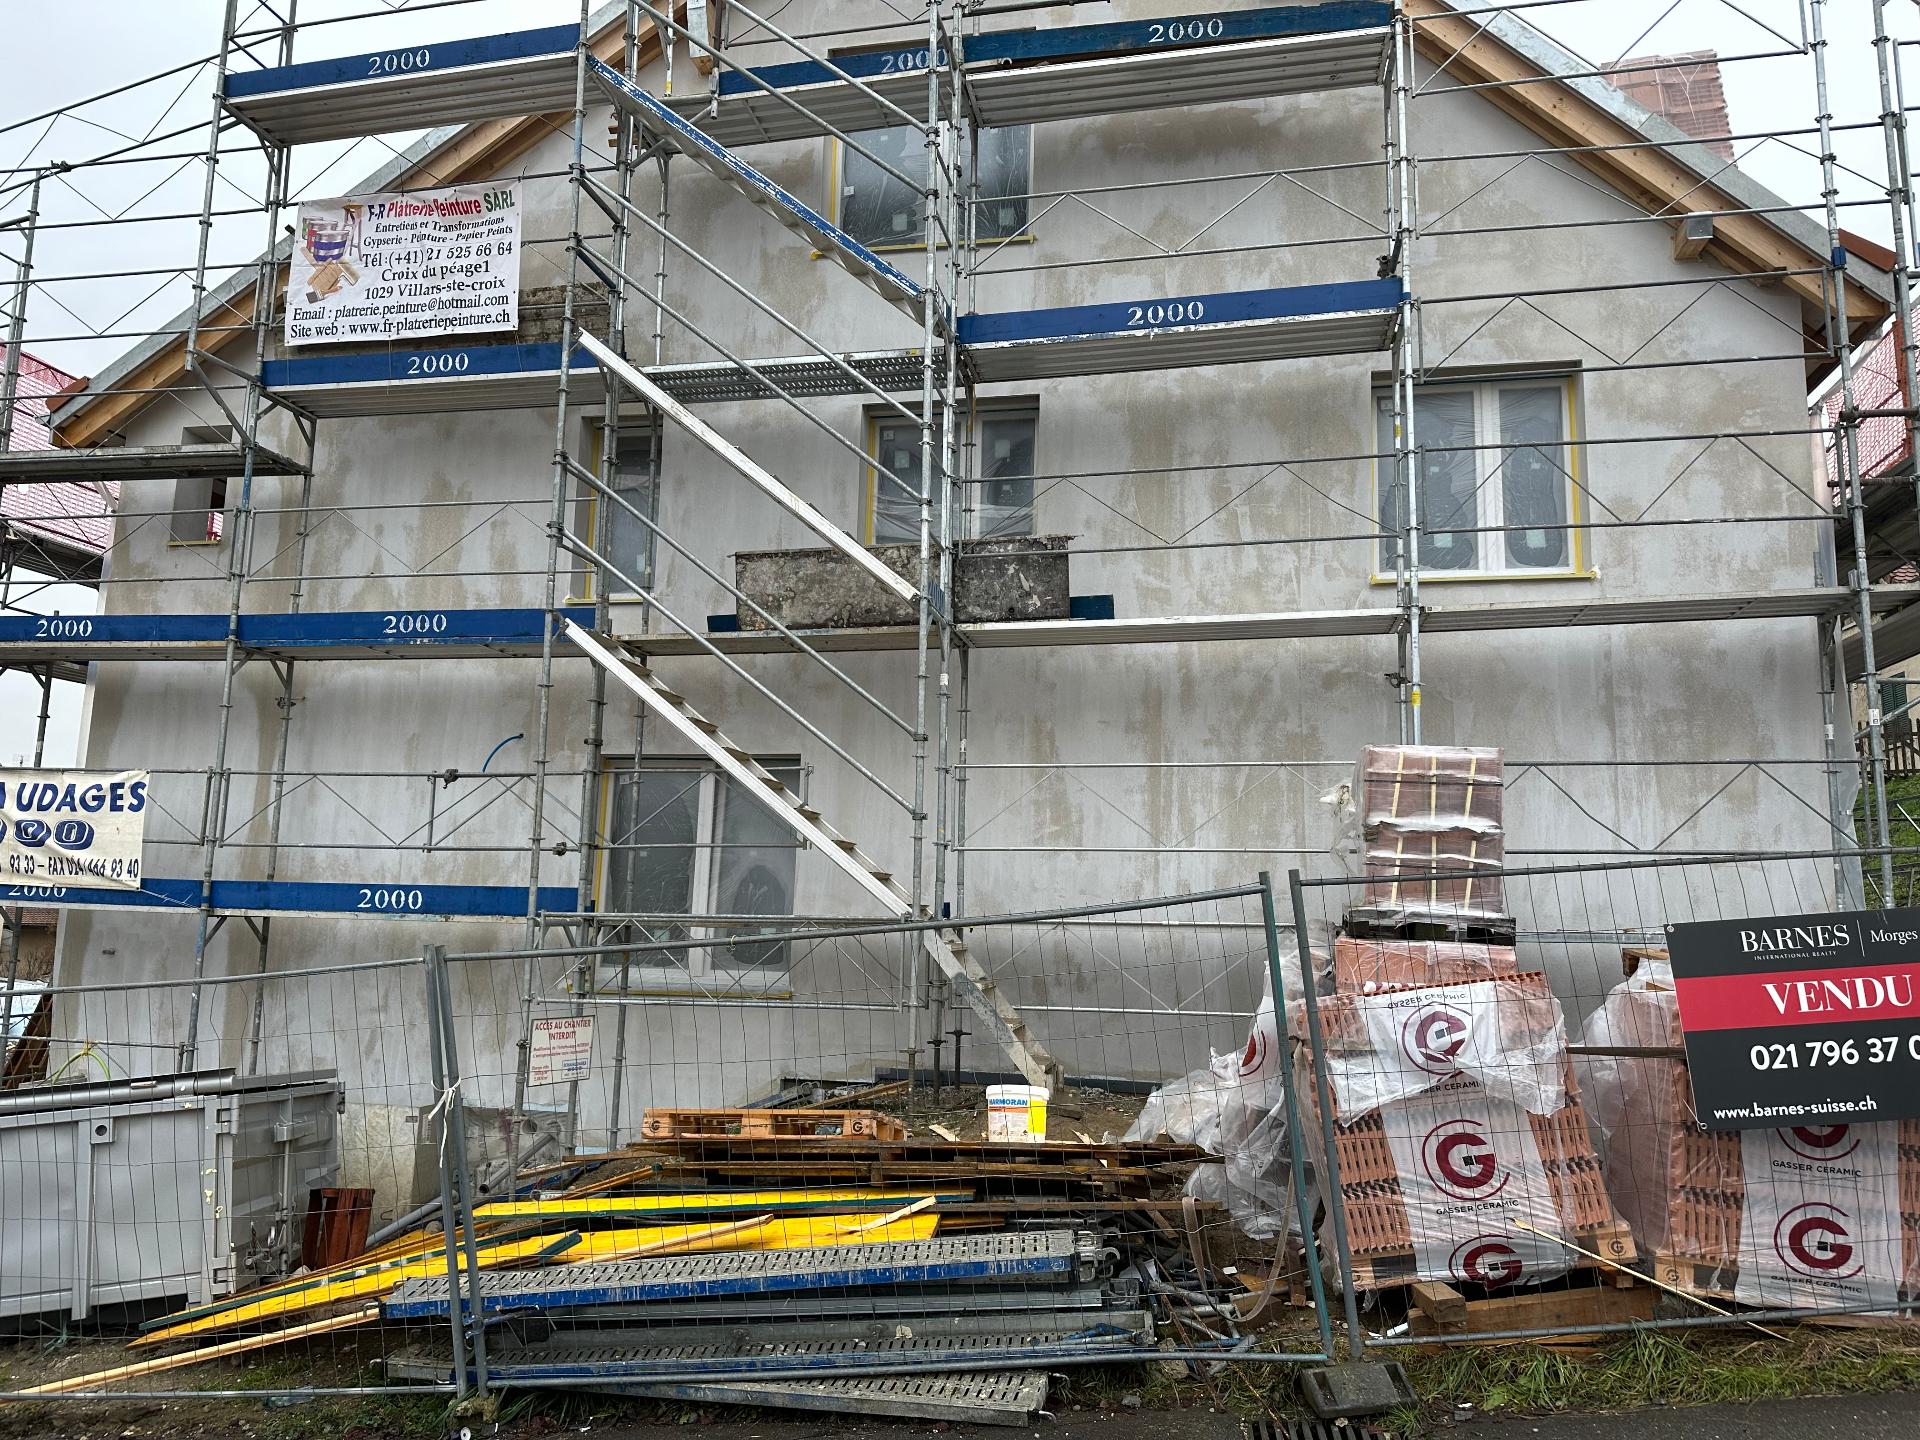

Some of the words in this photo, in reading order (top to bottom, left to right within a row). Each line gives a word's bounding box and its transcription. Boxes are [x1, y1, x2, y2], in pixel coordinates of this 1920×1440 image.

[1148, 18, 1223, 43] 2000
[367, 49, 430, 75] 2000
[881, 48, 948, 73] 2000
[433, 197, 482, 218] Peinture
[375, 220, 418, 233] Entretiens
[420, 220, 429, 229] et
[432, 216, 505, 233] Transformations
[363, 235, 403, 249] Gypserie
[411, 231, 447, 243] Peinture
[455, 230, 485, 242] Papier
[487, 225, 513, 237] Peints
[426, 248, 441, 261] 21
[446, 245, 472, 259] 525
[475, 243, 492, 257] 66
[497, 241, 513, 256] 64
[381, 268, 418, 282] Croix
[422, 264, 437, 278] du
[440, 260, 490, 281] péage1
[365, 286, 393, 300] 1029
[398, 276, 506, 297] Villars-ste-croix
[292, 306, 325, 321] Email
[334, 294, 509, 322] platrerie.peinture@hotmail.com
[1127, 301, 1204, 326] 2000
[290, 323, 312, 339] Site
[315, 321, 339, 337] web
[348, 309, 511, 336] www.fr-platreriepeinture.ch
[407, 352, 469, 375] 2000
[35, 619, 93, 637] 2000
[382, 614, 447, 634] 2000
[9, 854, 21, 874] 93
[24, 854, 35, 874] 33
[48, 856, 65, 876] FAX
[110, 858, 123, 878] 93
[127, 858, 139, 879] 40
[357, 888, 423, 910] 2000
[1738, 923, 1850, 953] BARNES
[1870, 928, 1918, 945] Morges
[1754, 951, 1811, 961] INTERNATIONAL
[1761, 974, 1912, 1015] VENDU
[1750, 1043, 1799, 1070] 021
[1805, 1039, 1860, 1067] 796
[1866, 1036, 1899, 1064] 37
[1445, 1081, 1482, 1091] CERAMI
[1713, 1095, 1877, 1119] www.barnes-suisse.ch
[1772, 1160, 1813, 1172] GASSER
[1816, 1166, 1862, 1178] CERAMIC
[1436, 1205, 1474, 1215] GASSER
[1477, 1200, 1519, 1211] CERAMIC
[1771, 1275, 1813, 1285] GASSER
[1815, 1280, 1863, 1293] CERAMIC
